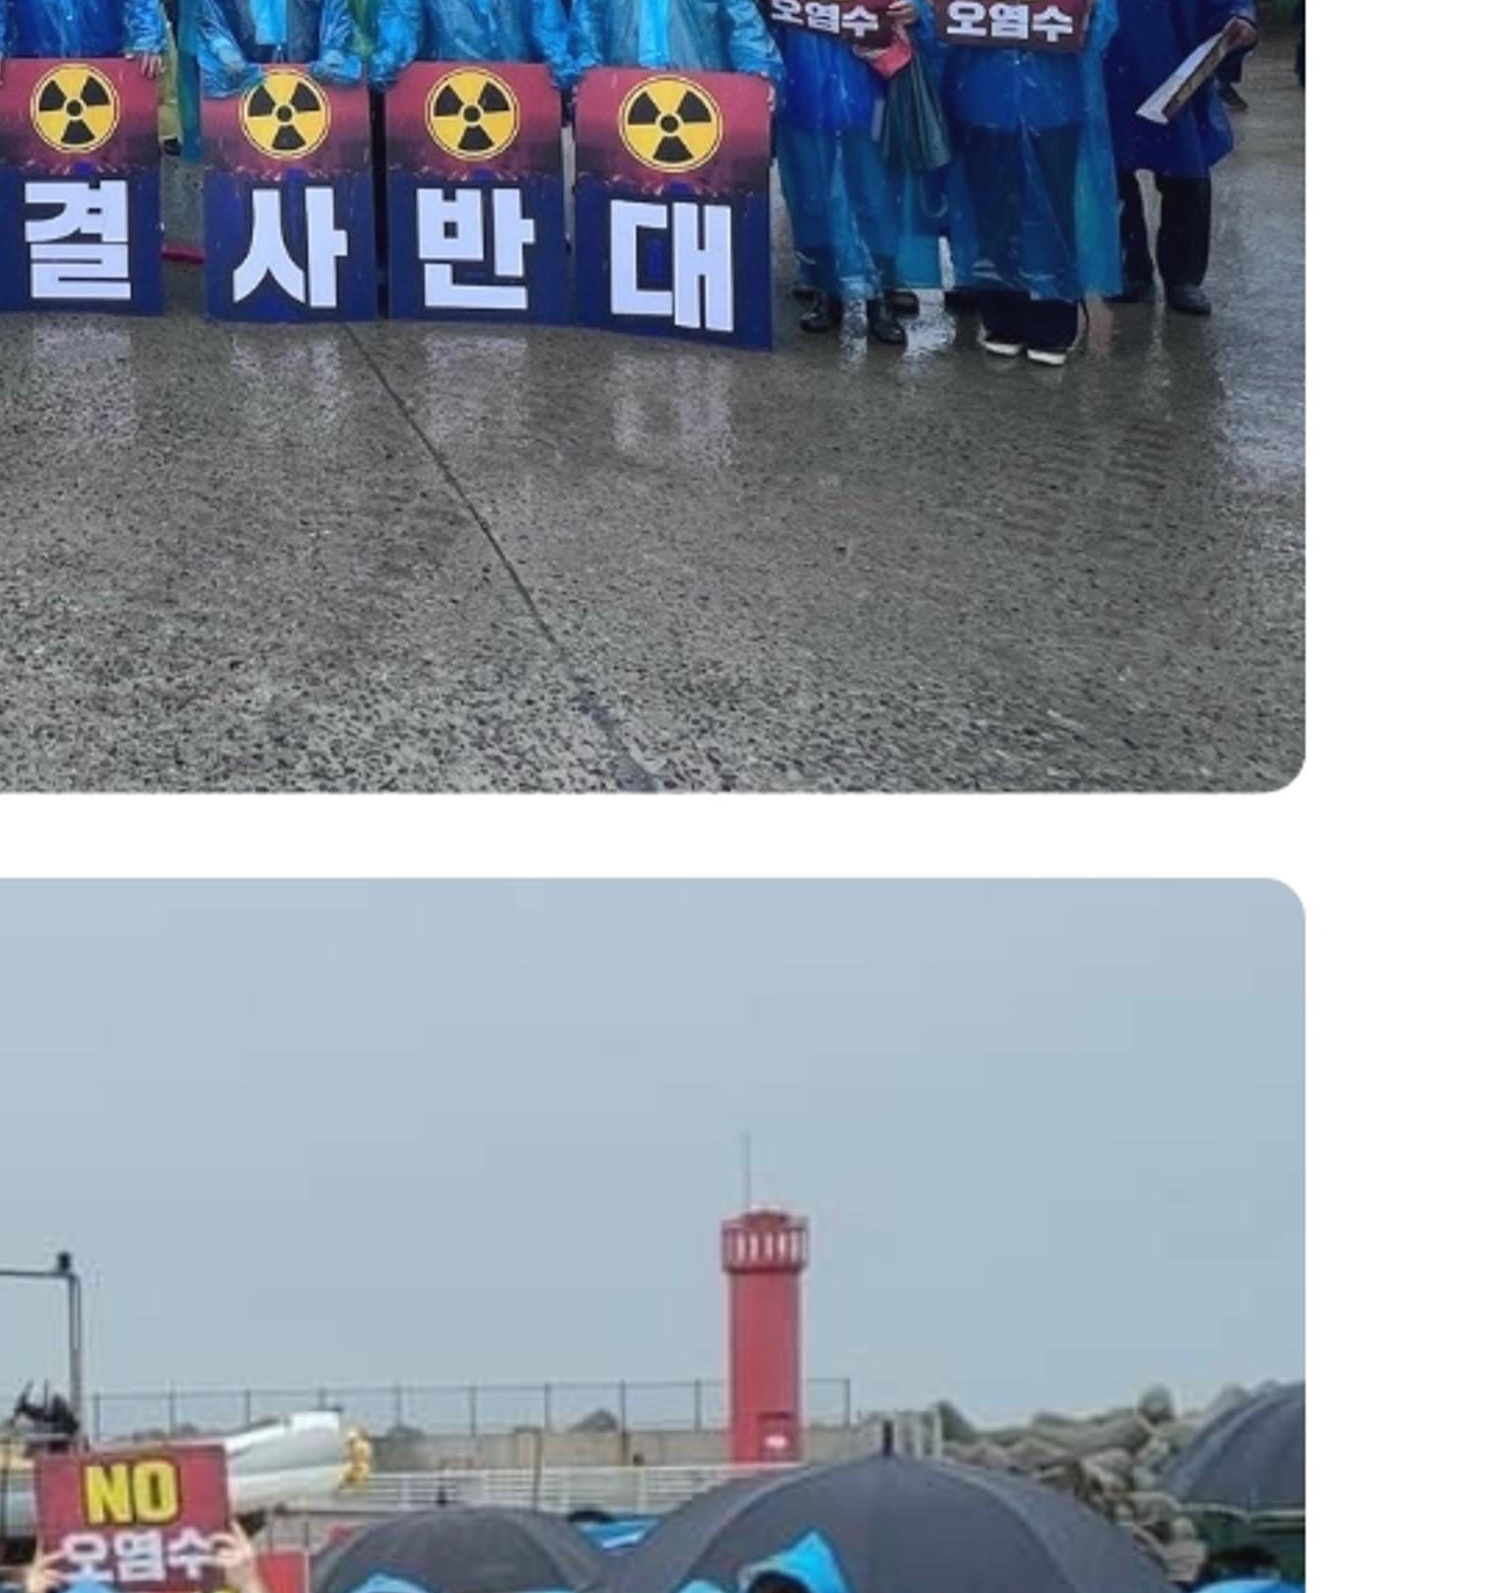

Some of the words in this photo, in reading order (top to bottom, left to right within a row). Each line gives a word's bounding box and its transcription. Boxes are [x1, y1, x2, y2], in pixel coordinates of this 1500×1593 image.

[947, 0, 1073, 42] 오염수
[25, 180, 131, 300] 결
[233, 187, 347, 307] 사
[417, 187, 534, 309] 반
[610, 200, 734, 332] 대
[84, 1461, 178, 1523] NO
[60, 1526, 214, 1582] 오염수
